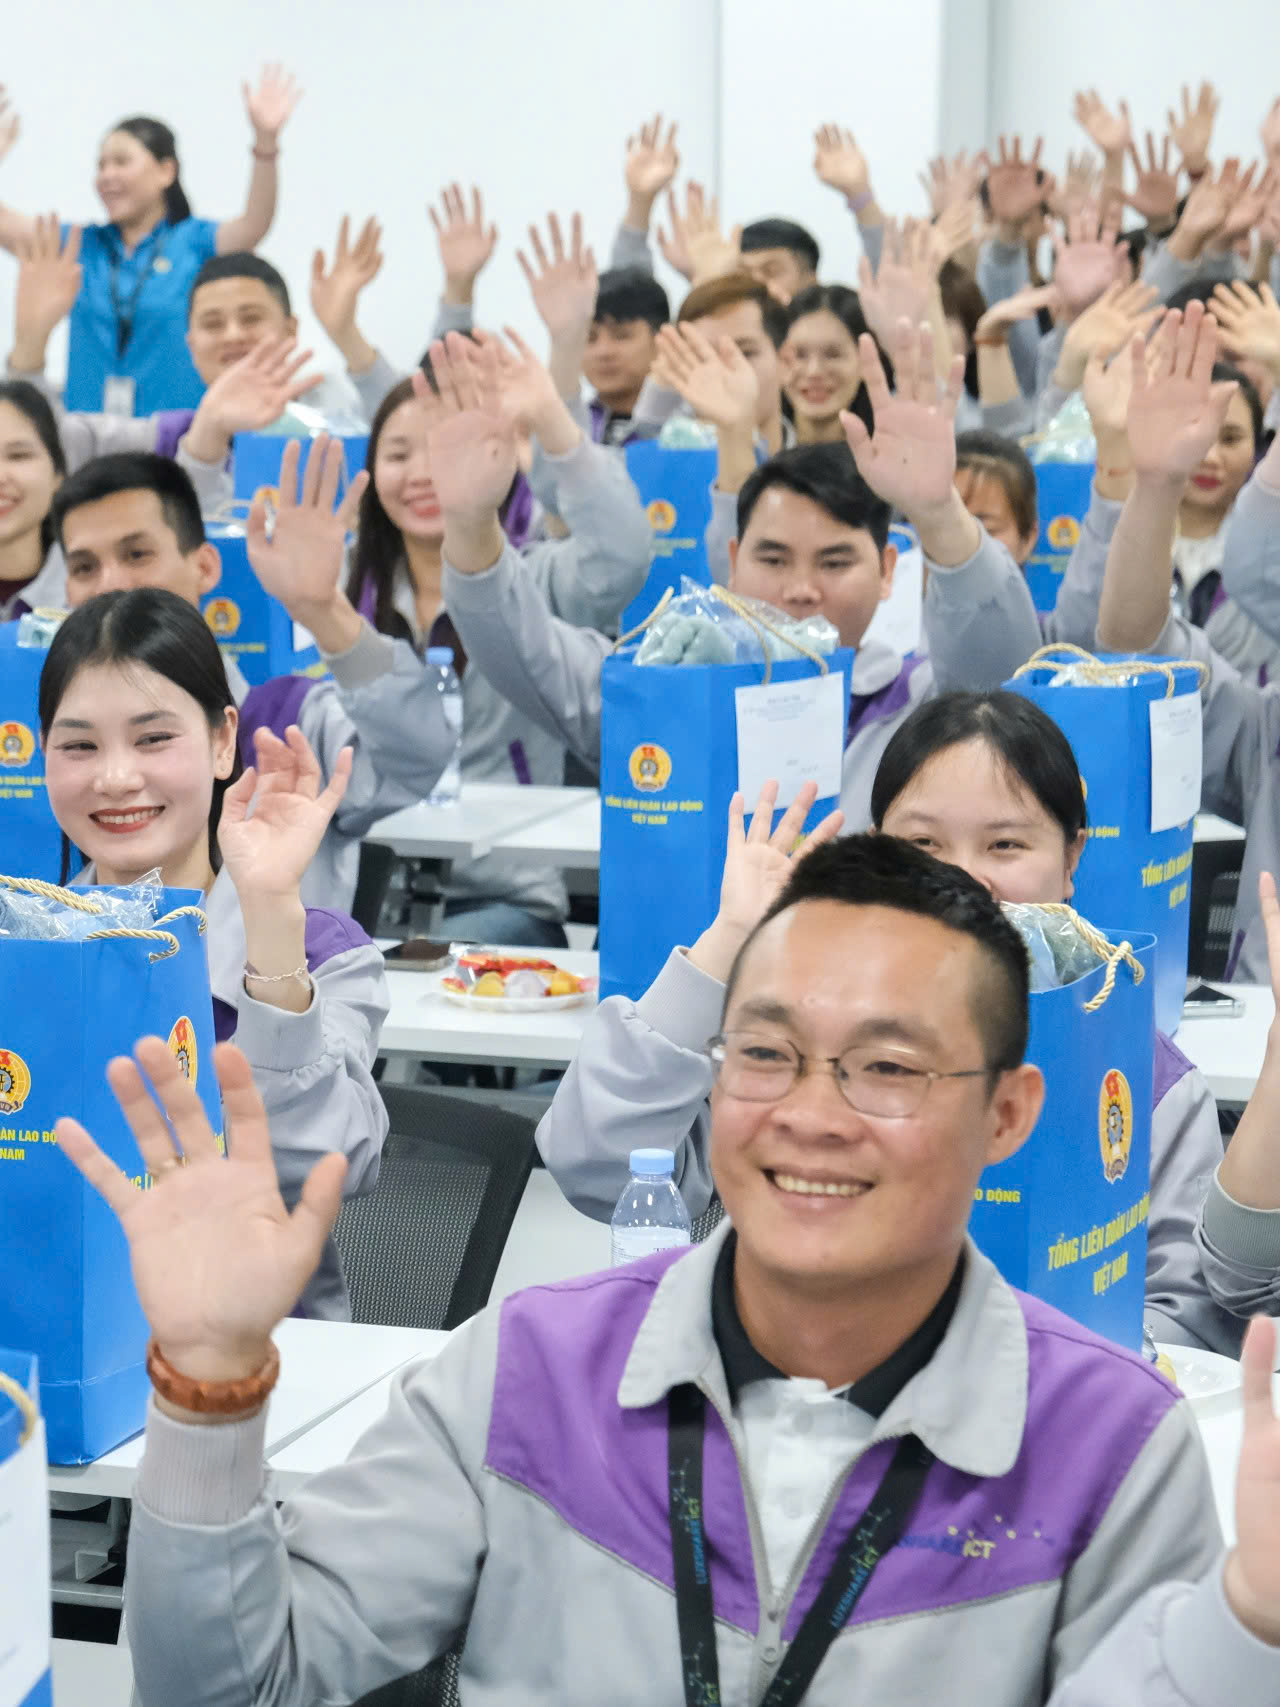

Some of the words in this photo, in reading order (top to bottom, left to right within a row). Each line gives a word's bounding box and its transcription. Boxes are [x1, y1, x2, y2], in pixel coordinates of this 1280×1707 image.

[18, 1129, 39, 1143] LAO
[41, 1128, 57, 1146] ĐỘ
[0, 1147, 25, 1161] NAM
[985, 1186, 1021, 1205] ĐỘNG
[1047, 1232, 1080, 1272] TỔNG
